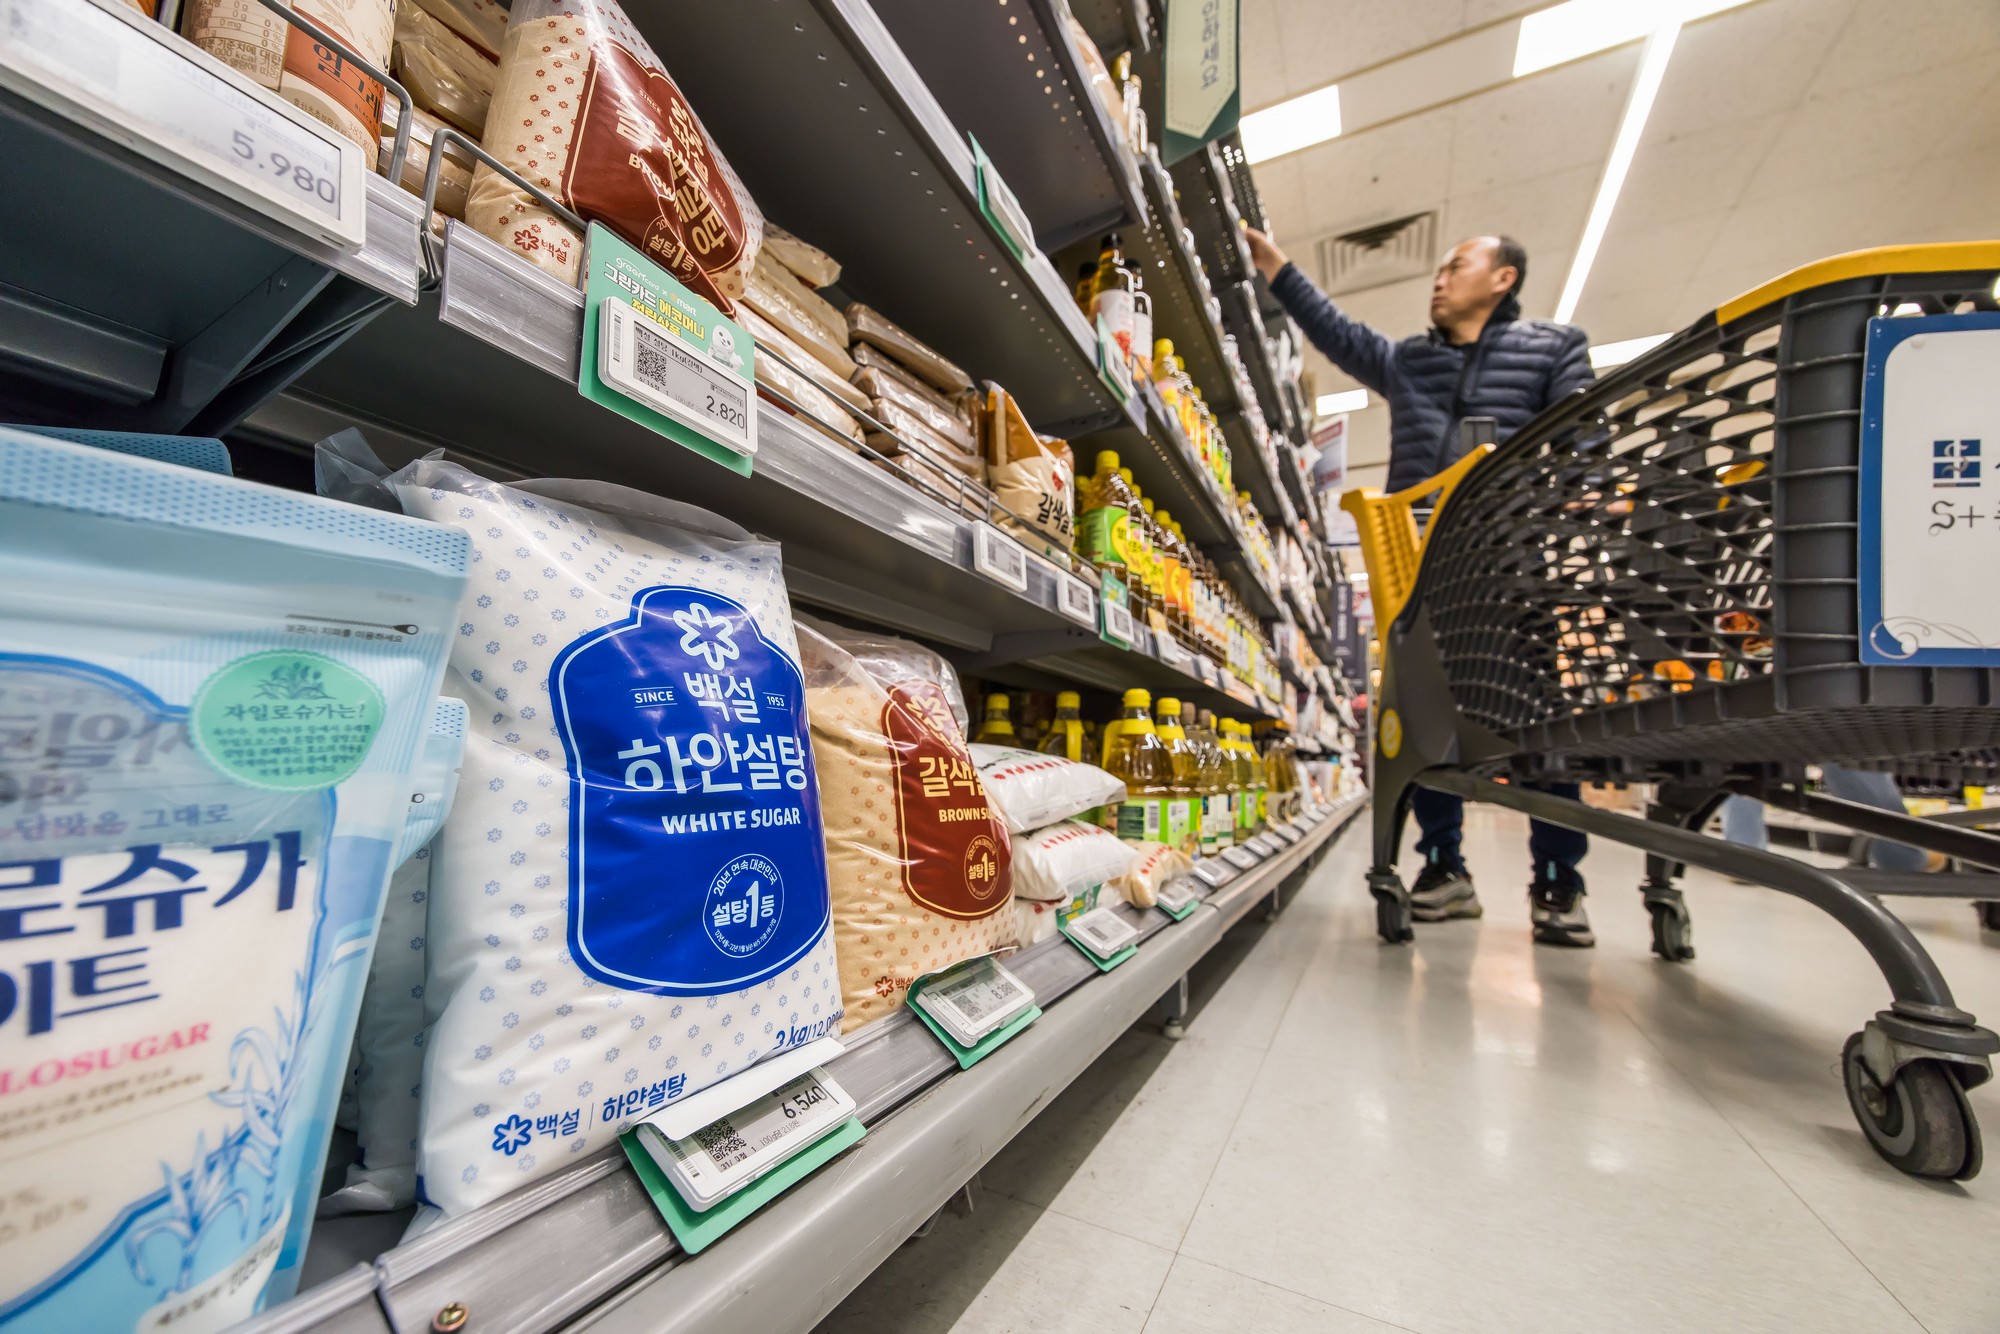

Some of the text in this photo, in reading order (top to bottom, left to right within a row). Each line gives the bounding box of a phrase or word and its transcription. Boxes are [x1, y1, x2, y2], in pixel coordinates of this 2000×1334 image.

[541, 239, 568, 266] 백설
[603, 261, 706, 341] 그린카드 에코머니
[635, 671, 786, 724] SINCE 백설 1953
[617, 732, 808, 795] 하얀설탕
[661, 806, 801, 836] WHITE SUGAR
[938, 808, 980, 823] BROWN
[713, 858, 778, 897] 20년 연속 대한민국
[968, 851, 996, 883] 설탕1등
[711, 880, 775, 928] 설탕1등
[535, 1072, 688, 1140] 백설 하얀설탕
[782, 1085, 829, 1120] 6,540
